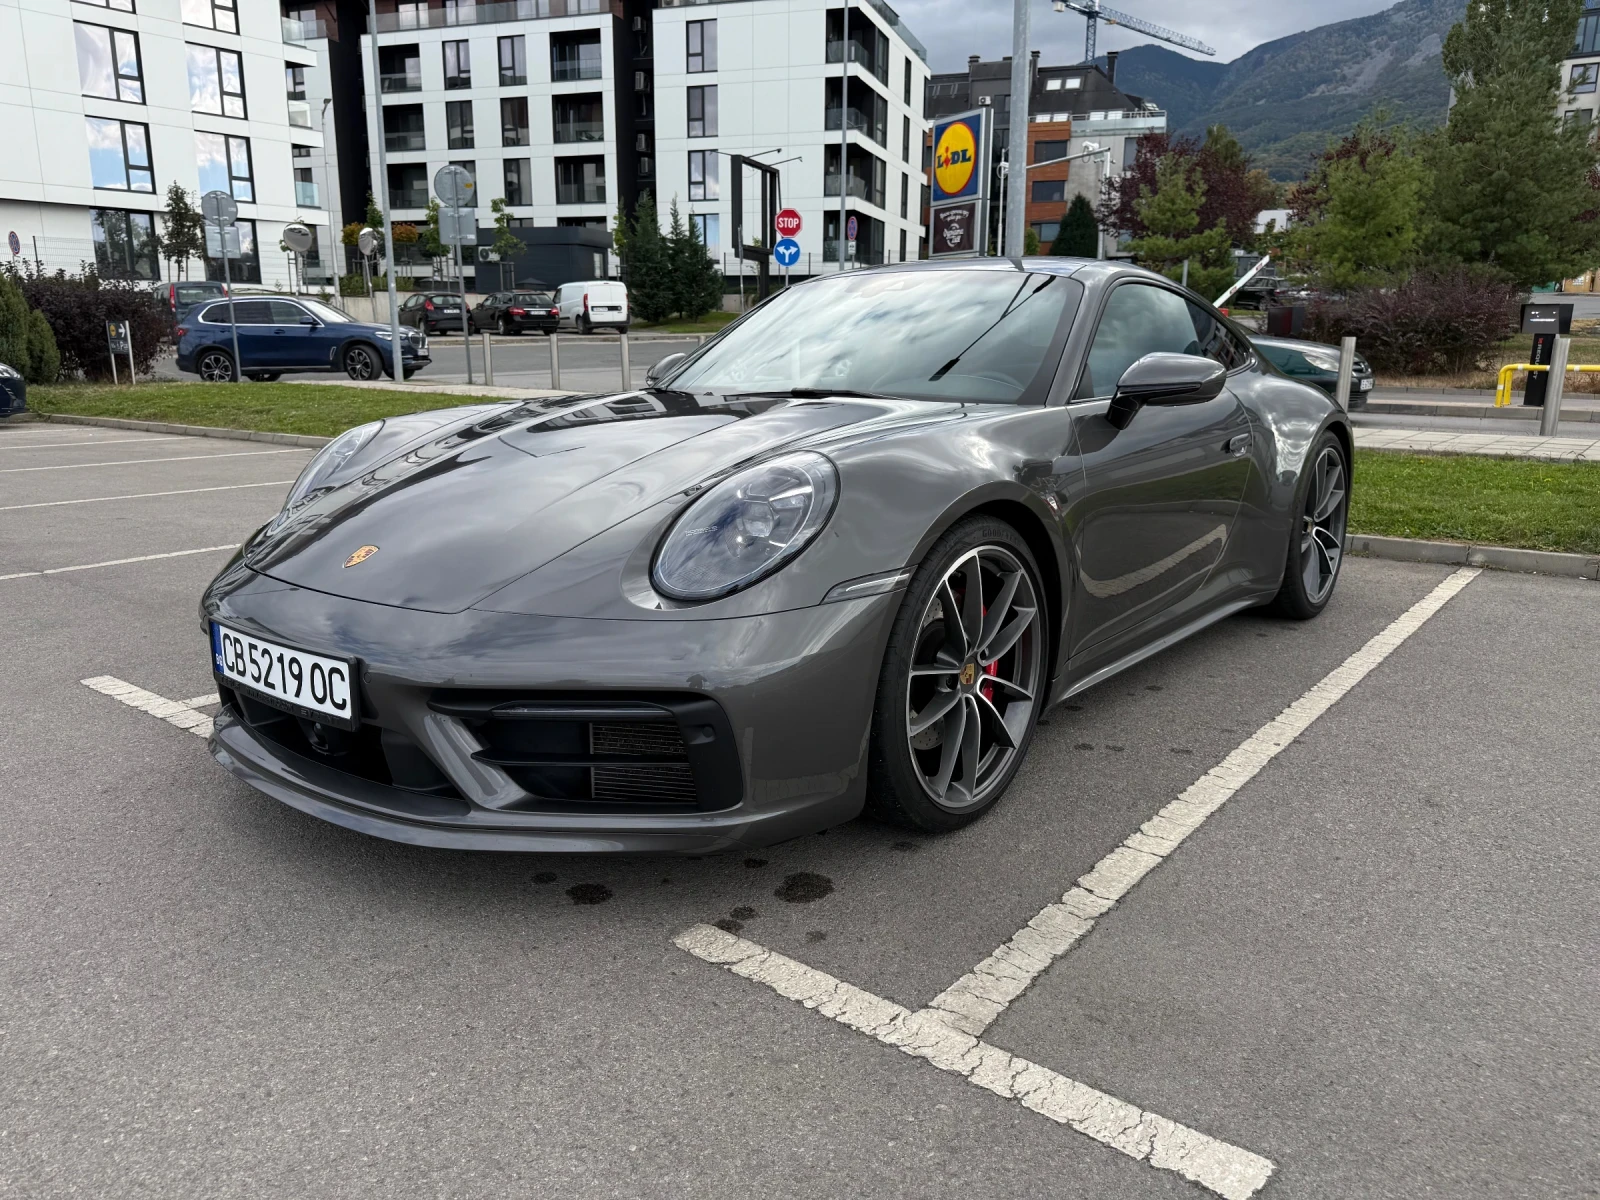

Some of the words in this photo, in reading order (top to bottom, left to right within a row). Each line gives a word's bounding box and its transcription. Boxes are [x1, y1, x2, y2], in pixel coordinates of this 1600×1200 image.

[778, 217, 799, 229] STOP
[1533, 344, 1542, 380] REQUST
[222, 633, 246, 677] CB
[248, 642, 303, 698] 5219
